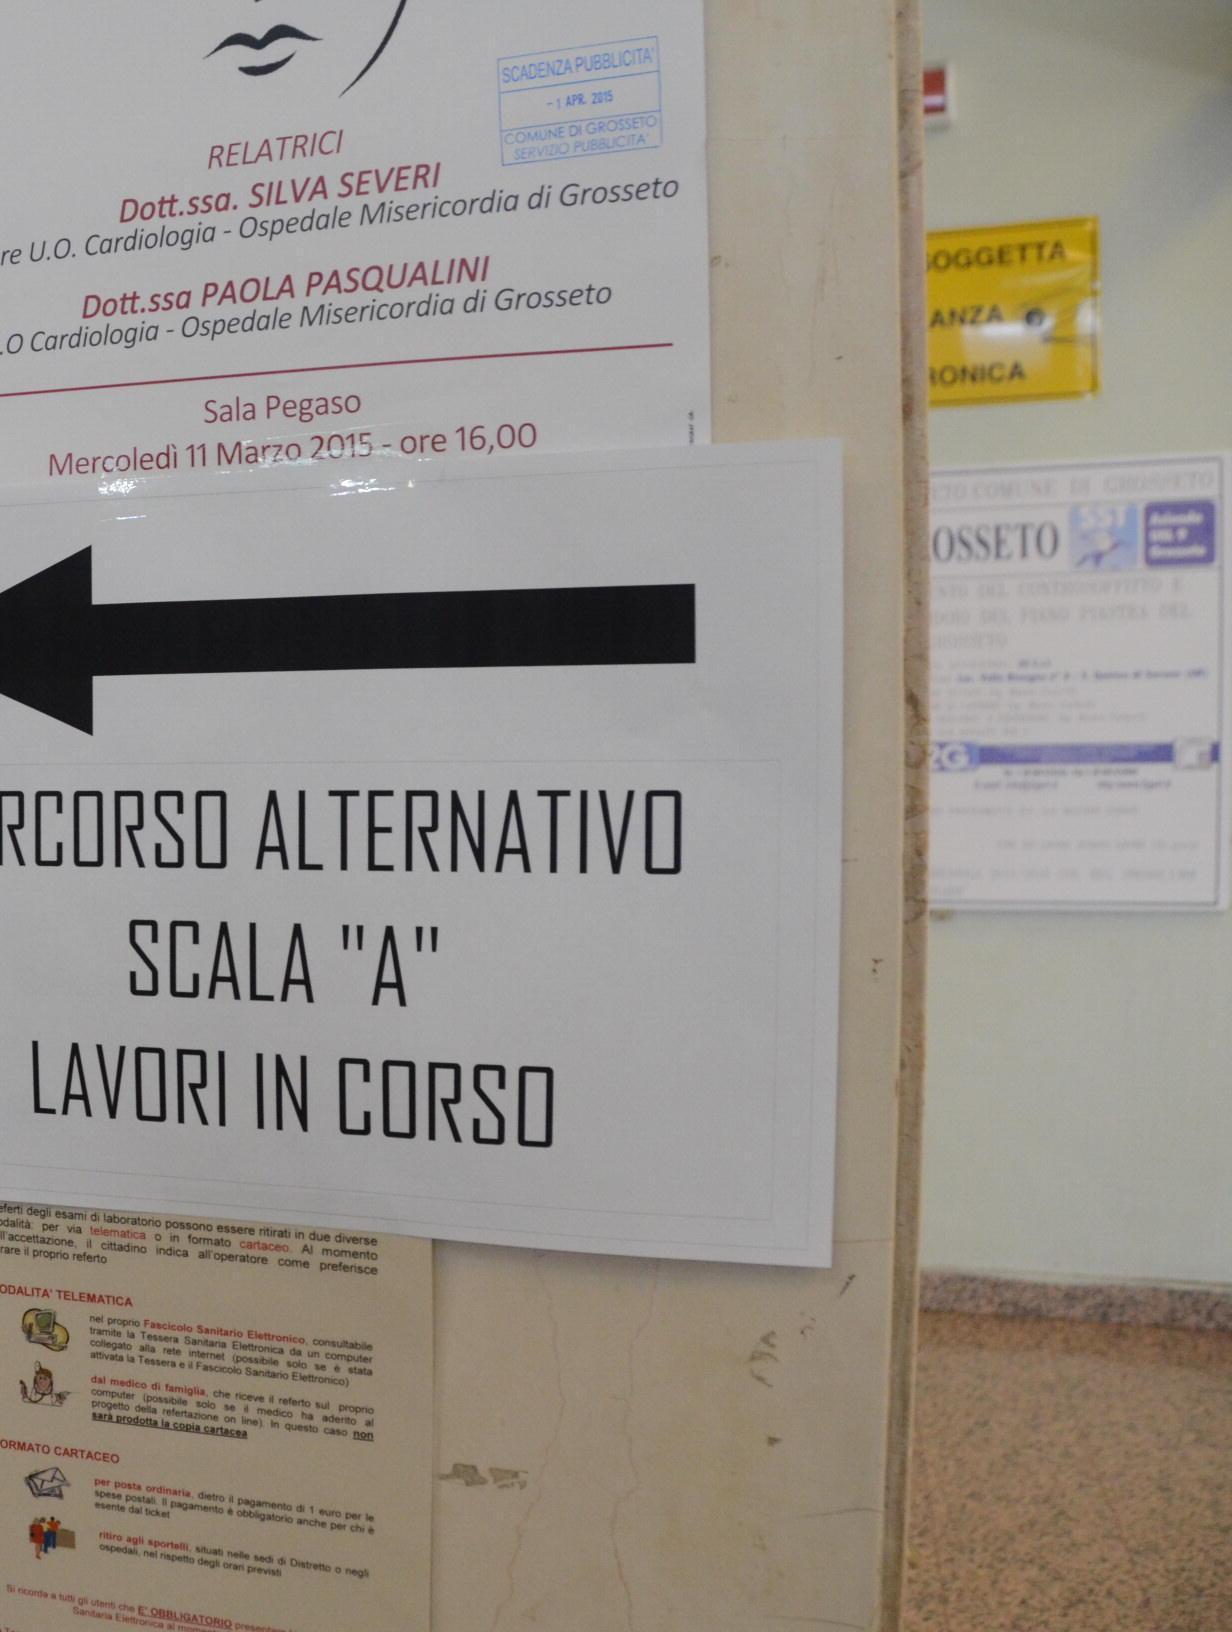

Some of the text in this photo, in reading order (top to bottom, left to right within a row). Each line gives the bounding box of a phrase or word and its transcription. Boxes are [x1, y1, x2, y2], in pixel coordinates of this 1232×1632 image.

[502, 57, 573, 83] SCADENZA
[592, 90, 614, 105] 2015
[208, 129, 343, 169] RELATRICI
[504, 114, 658, 145] COMUNE DI GROSSETO
[514, 142, 569, 161] SERVIZIO
[120, 162, 440, 223] Dott.ssa. SILVA SEVERI
[30, 237, 75, 263] U.O.
[85, 222, 216, 256] Cardiologia
[239, 205, 352, 241] Ospedale
[360, 189, 519, 226] Misericordia
[528, 185, 552, 210] di
[560, 177, 679, 207] Grosseto
[82, 255, 489, 319] Dott.ssa PAOLA PASQUALINI
[30, 321, 159, 353] Cardiologia
[182, 307, 292, 342] Ospedale
[300, 293, 455, 328] Misericordia
[463, 288, 487, 313] di
[495, 284, 612, 311] Grosseto
[204, 394, 361, 424] Sala Pegaso
[49, 443, 177, 476] Mercoledì
[186, 443, 206, 467] 11
[217, 440, 301, 466] Marzo
[310, 431, 373, 460] 2015
[400, 433, 447, 454] ore
[456, 422, 537, 454] 16,00
[932, 520, 1059, 563] OSSETO
[255, 789, 682, 875] ALTERNATIVO
[129, 920, 438, 1007] SCALA "A"
[32, 1040, 553, 1148] LAVORI IN CORSO
[26, 1204, 53, 1220] degli
[55, 1207, 87, 1221] esami
[104, 1212, 161, 1228] laboratorio
[165, 1220, 213, 1233] possono
[217, 1224, 255, 1236] essere
[259, 1226, 291, 1239] ritirati
[309, 1231, 331, 1243] due
[335, 1232, 378, 1246] diverse
[42, 1222, 59, 1232] per
[67, 1225, 82, 1235] via
[90, 1226, 146, 1240] telematica
[188, 1233, 231, 1248] formato
[322, 1247, 378, 1261] momento
[33, 1249, 69, 1261] proprio
[72, 1251, 107, 1264] referto
[101, 1240, 147, 1254] cittadino
[156, 1246, 189, 1258] indica
[198, 1249, 268, 1265] all'operatore
[278, 1258, 310, 1269] come
[320, 1261, 378, 1275] preferisce
[56, 1289, 133, 1307] TELEMATICA
[89, 1315, 103, 1324] nel
[107, 1317, 140, 1330] proprio
[144, 1319, 193, 1333] Fascicolo
[197, 1324, 243, 1338] Sanitario
[313, 1338, 373, 1351] consultabile
[90, 1350, 124, 1363] attivata
[138, 1355, 176, 1368] Tessera
[196, 1361, 242, 1375] Fascicolo
[245, 1366, 289, 1380] Sanitario
[291, 1371, 349, 1388] Elettronico)
[54, 1446, 119, 1464] CARTACEO
[94, 1478, 111, 1487] per
[114, 1481, 142, 1491] posta
[198, 1491, 225, 1503] dietro
[237, 1497, 292, 1512] pagamento
[319, 1509, 341, 1519] euro
[345, 1512, 361, 1521] per
[95, 1502, 170, 1519] esente dal ticket
[99, 1531, 123, 1542] ritiro
[126, 1535, 144, 1548] agli
[195, 1545, 223, 1557] situati
[227, 1550, 250, 1561] nelle
[254, 1555, 274, 1564] sedi
[290, 1557, 331, 1572] Distretto
[345, 1568, 369, 1580] negli
